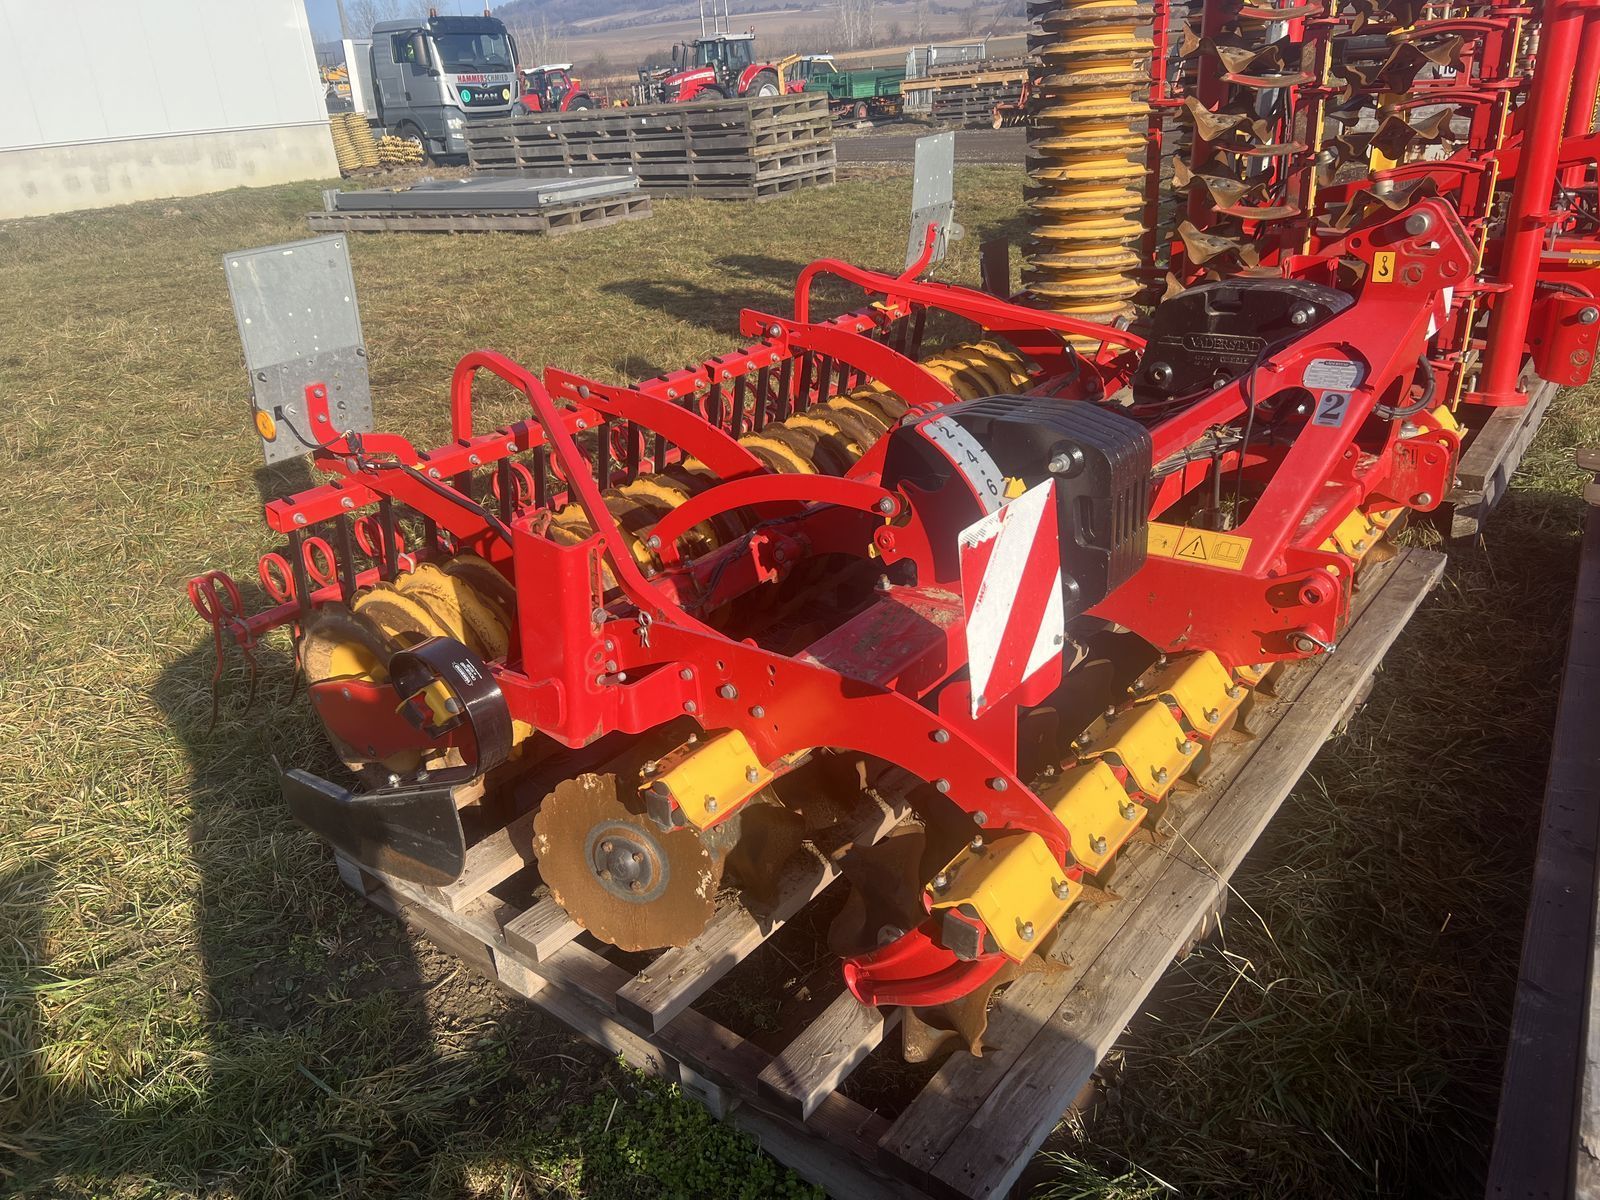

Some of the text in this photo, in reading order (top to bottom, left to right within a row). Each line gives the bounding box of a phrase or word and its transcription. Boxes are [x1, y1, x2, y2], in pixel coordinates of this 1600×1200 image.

[457, 74, 509, 83] HAMMERSCHMIED
[474, 92, 498, 101] MAN
[1319, 394, 1345, 420] 2
[938, 426, 998, 496] 2 4 6
